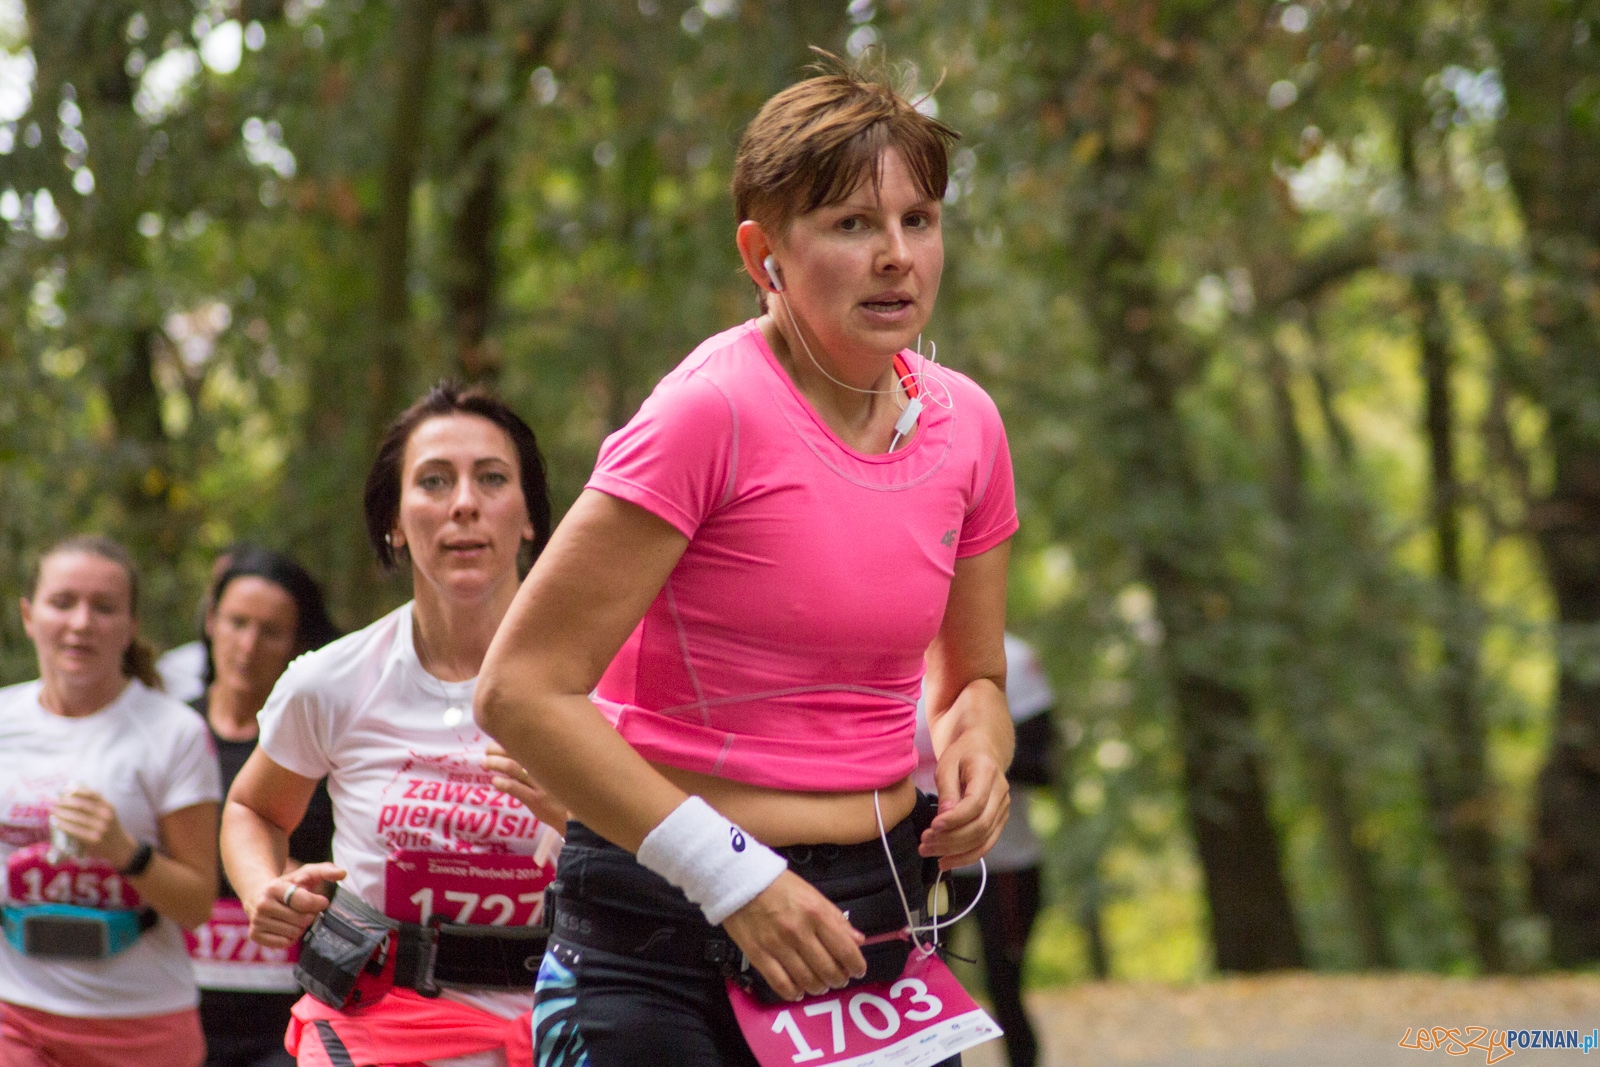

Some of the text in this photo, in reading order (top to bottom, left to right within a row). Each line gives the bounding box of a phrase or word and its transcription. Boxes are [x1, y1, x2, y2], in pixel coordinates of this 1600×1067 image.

[385, 831, 432, 848] 2016
[22, 867, 124, 907] 1451
[409, 887, 545, 927] 1727
[771, 977, 943, 1064] 1703
